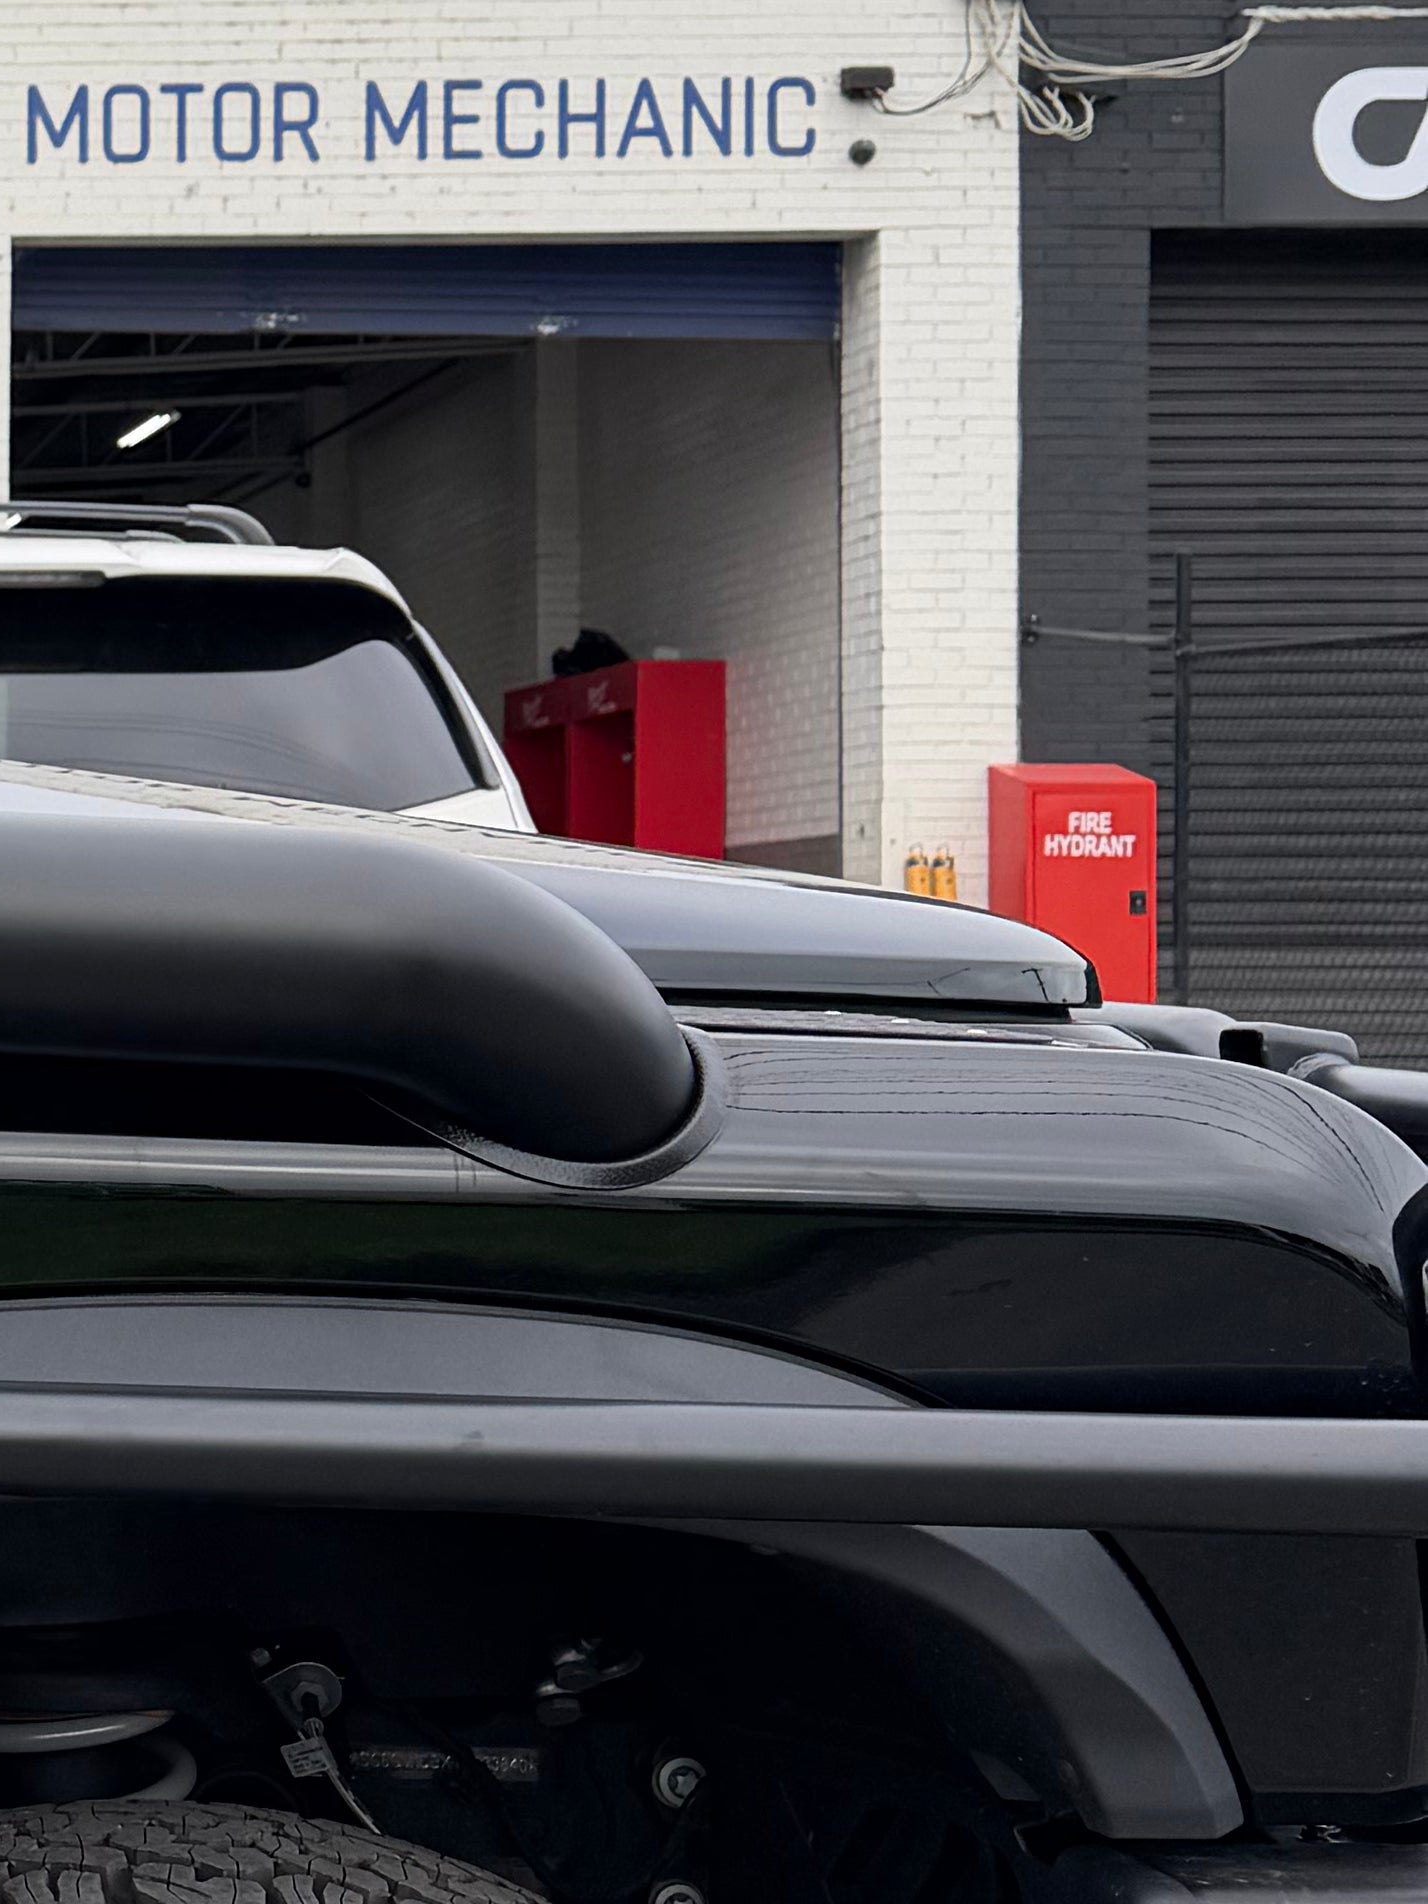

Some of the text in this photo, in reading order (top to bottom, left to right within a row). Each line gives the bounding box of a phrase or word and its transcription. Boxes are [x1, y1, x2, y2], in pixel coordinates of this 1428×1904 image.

[25, 76, 817, 166] MOTOR MECHANIC
[1068, 811, 1112, 834] FIRE
[1044, 834, 1137, 858] HYDRANT
